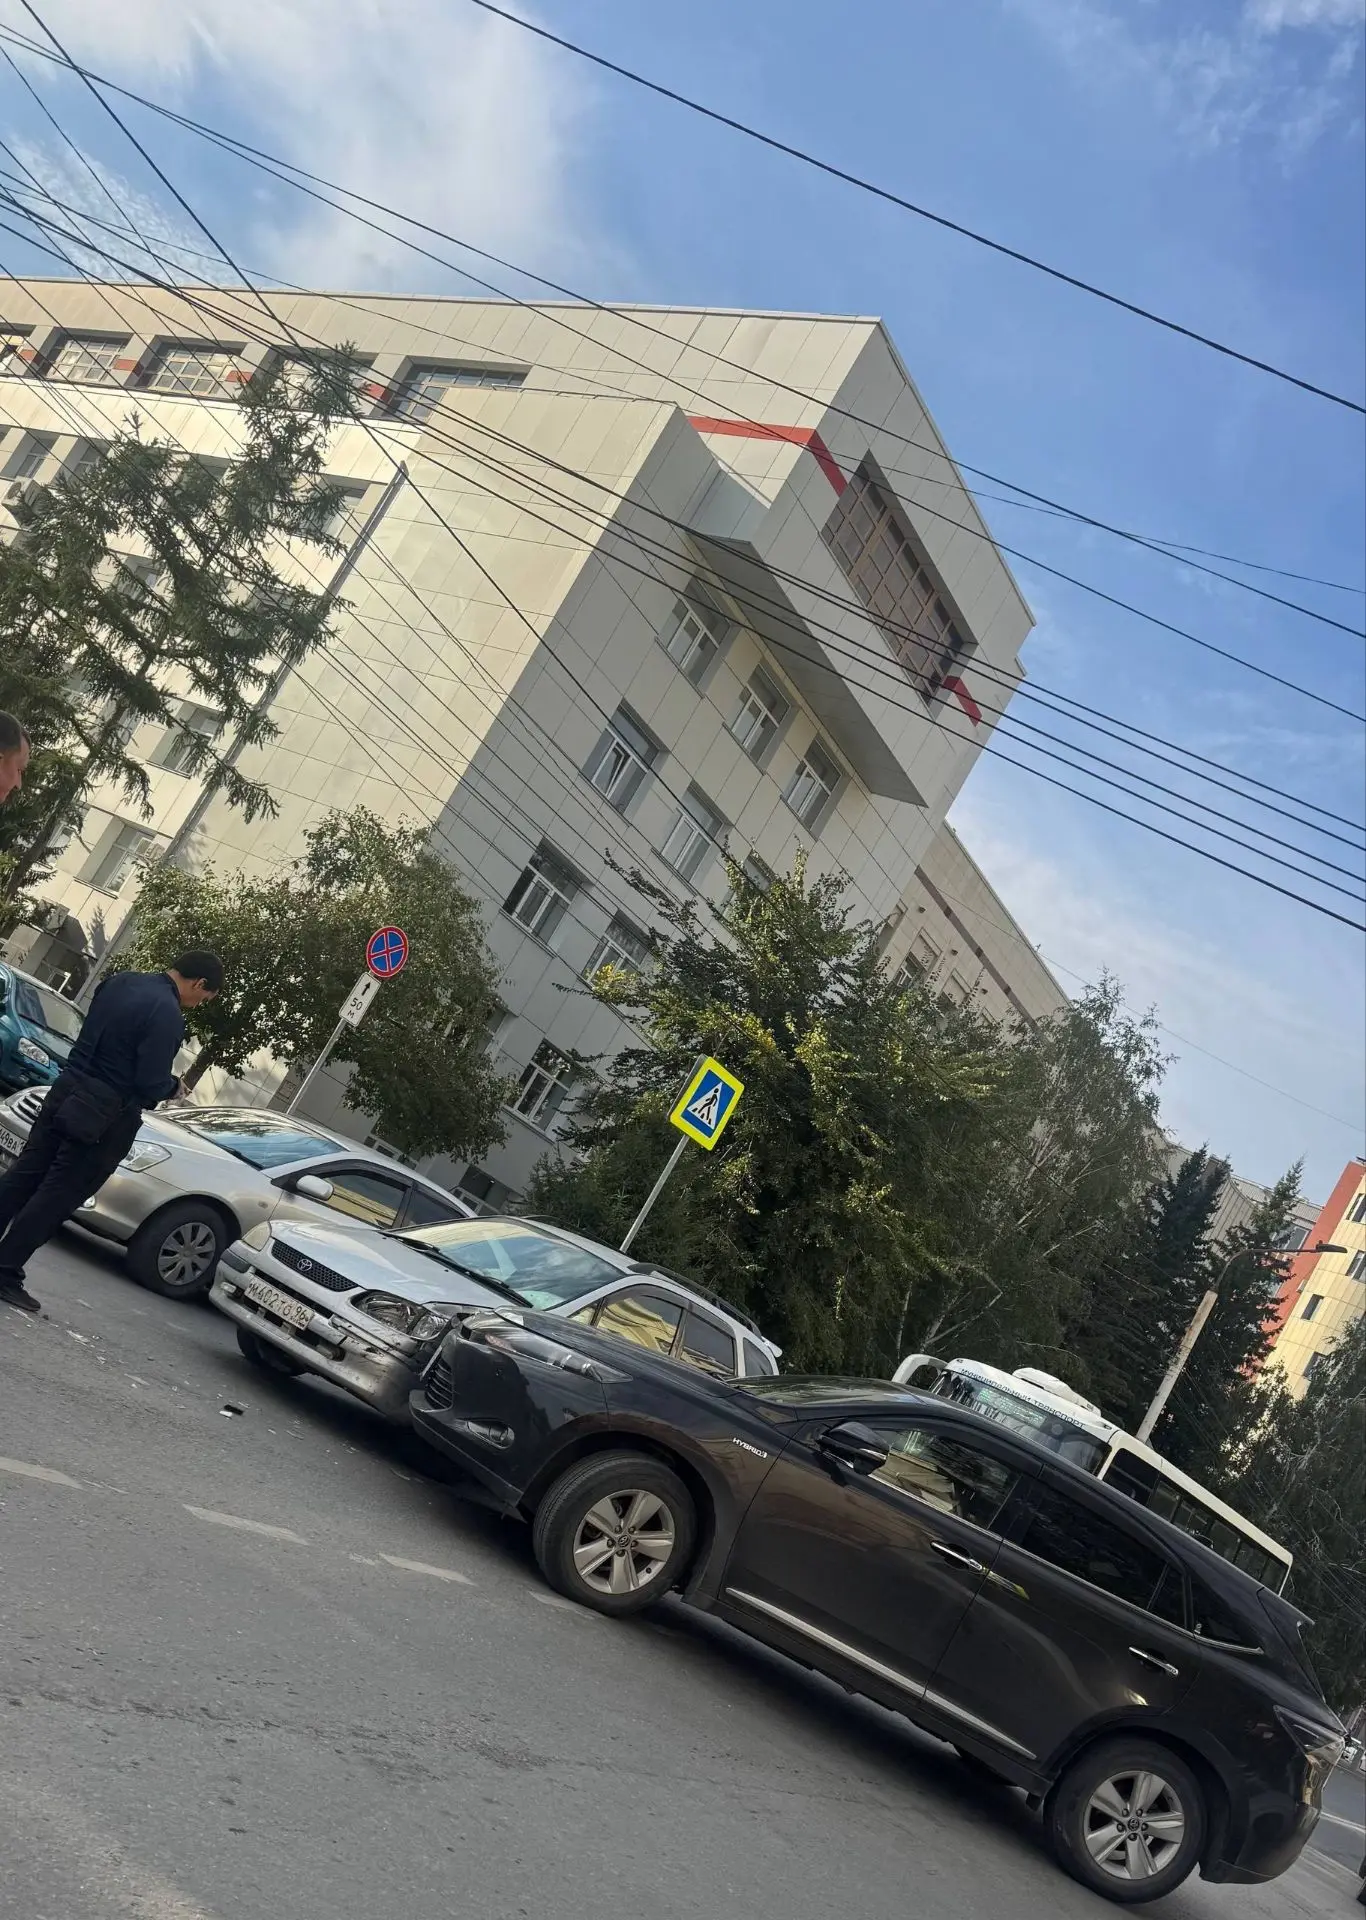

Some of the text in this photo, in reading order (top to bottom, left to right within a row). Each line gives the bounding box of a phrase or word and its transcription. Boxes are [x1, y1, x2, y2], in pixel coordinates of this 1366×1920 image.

[350, 997, 363, 1011] 50
[1033, 1400, 1086, 1428] ТРАНСПОРТ
[732, 1437, 763, 1457] HYBRID
